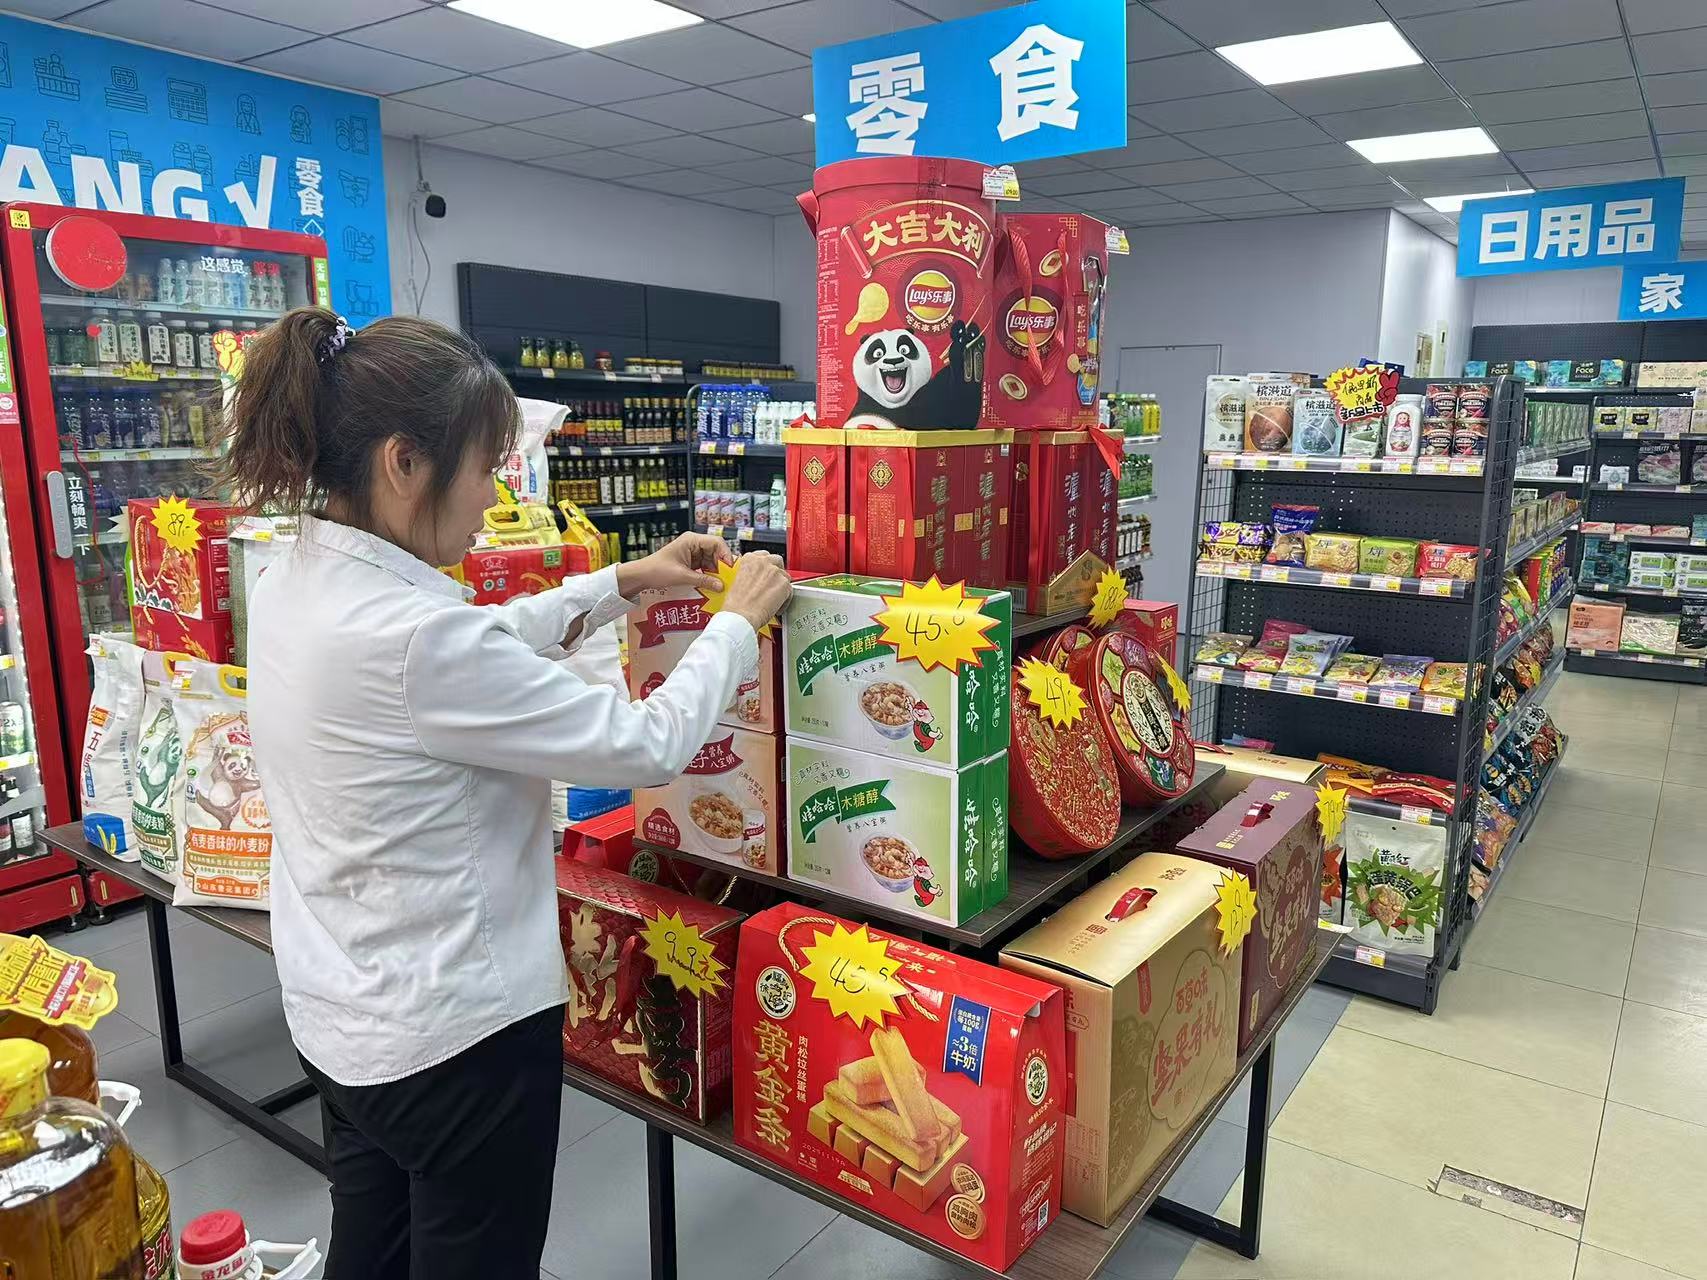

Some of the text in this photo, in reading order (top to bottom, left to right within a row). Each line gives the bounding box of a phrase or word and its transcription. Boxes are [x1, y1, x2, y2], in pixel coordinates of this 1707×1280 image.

[845, 24, 1084, 155] 零食
[295, 157, 324, 218] 零食
[863, 210, 985, 260] 大吉大利
[1478, 198, 1655, 264] 日用品
[1638, 273, 1685, 313] 家
[67, 476, 91, 556] 立刻畅爽一下
[799, 632, 878, 675] 娃哈哈 木糖醇
[964, 663, 980, 730] 哈哈
[710, 753, 735, 768] 八宝粥
[801, 788, 879, 823] 娃哈哈 木糖醇
[191, 833, 270, 853] 有麦香味的小麦粉
[951, 1050, 977, 1072] 牛奶
